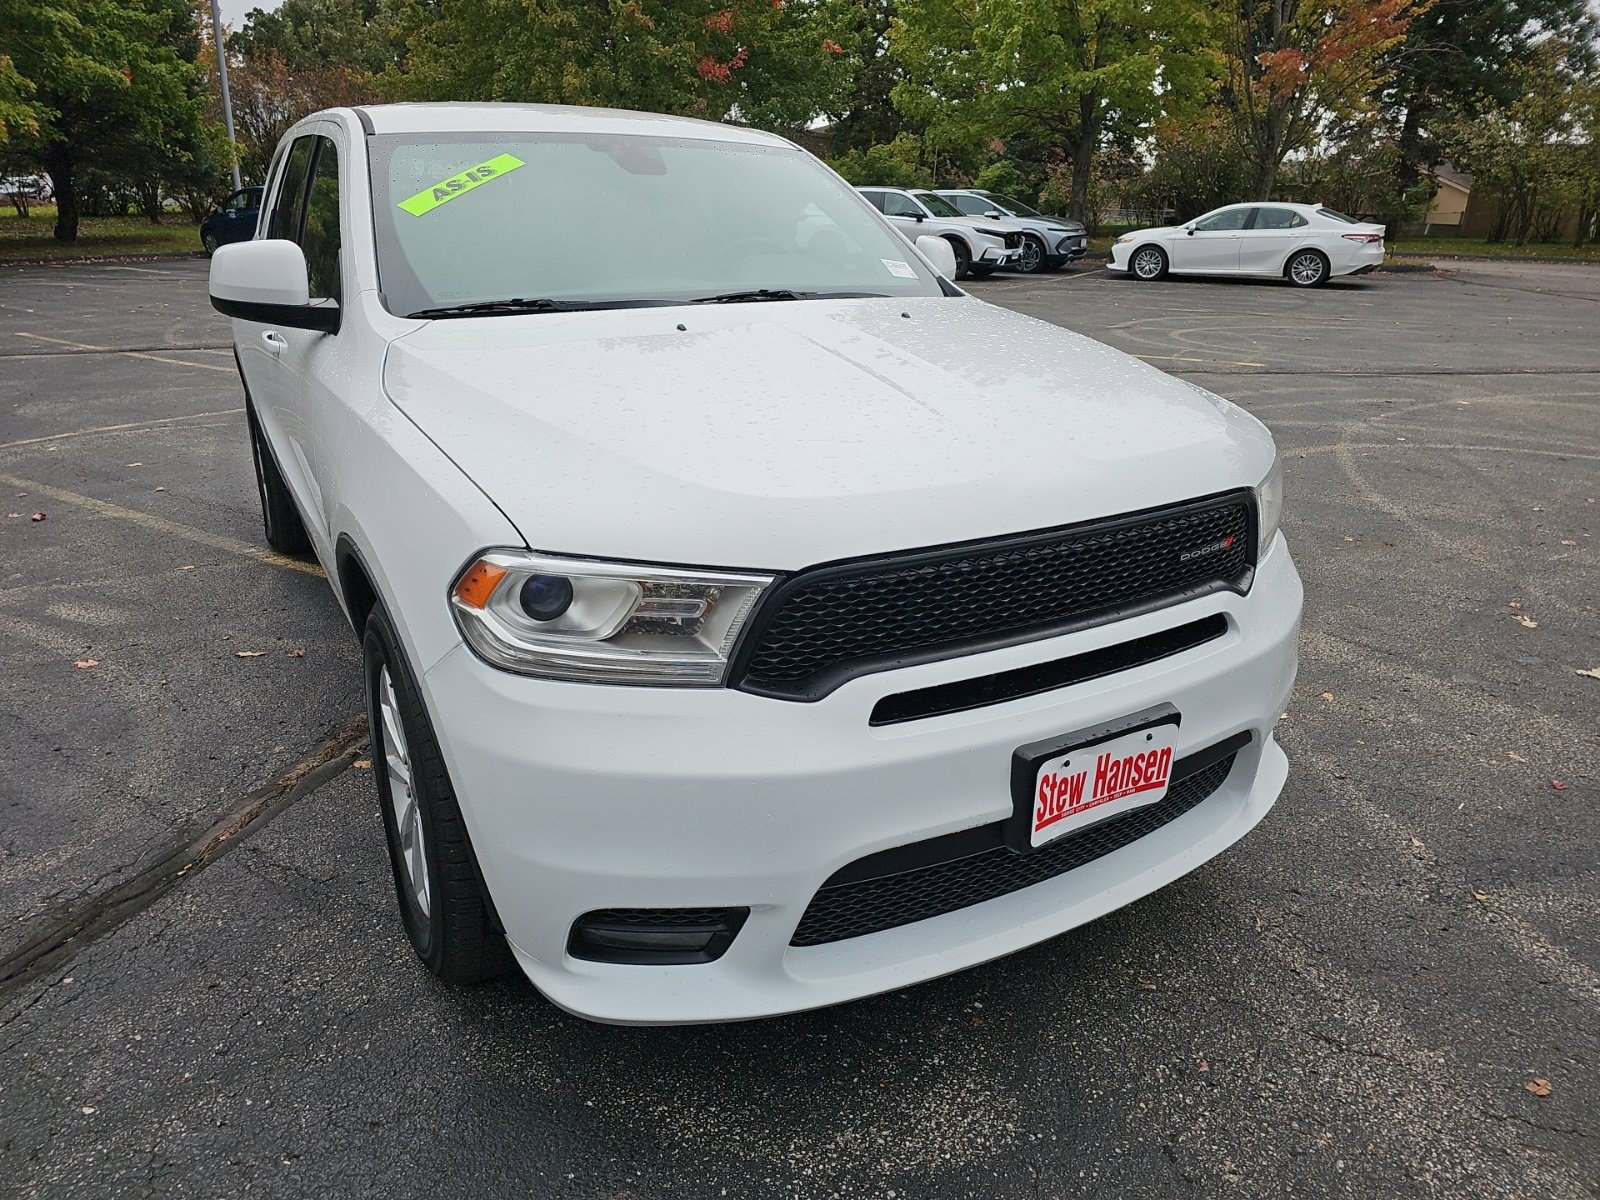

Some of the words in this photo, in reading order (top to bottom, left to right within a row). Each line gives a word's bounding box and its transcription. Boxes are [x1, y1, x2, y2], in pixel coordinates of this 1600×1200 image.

[432, 166, 493, 202] AS-IS
[1180, 542, 1225, 561] DODGE
[1036, 771, 1088, 823] Stew
[1092, 747, 1172, 799] Hansen
[1088, 796, 1110, 808] CHRYSLER
